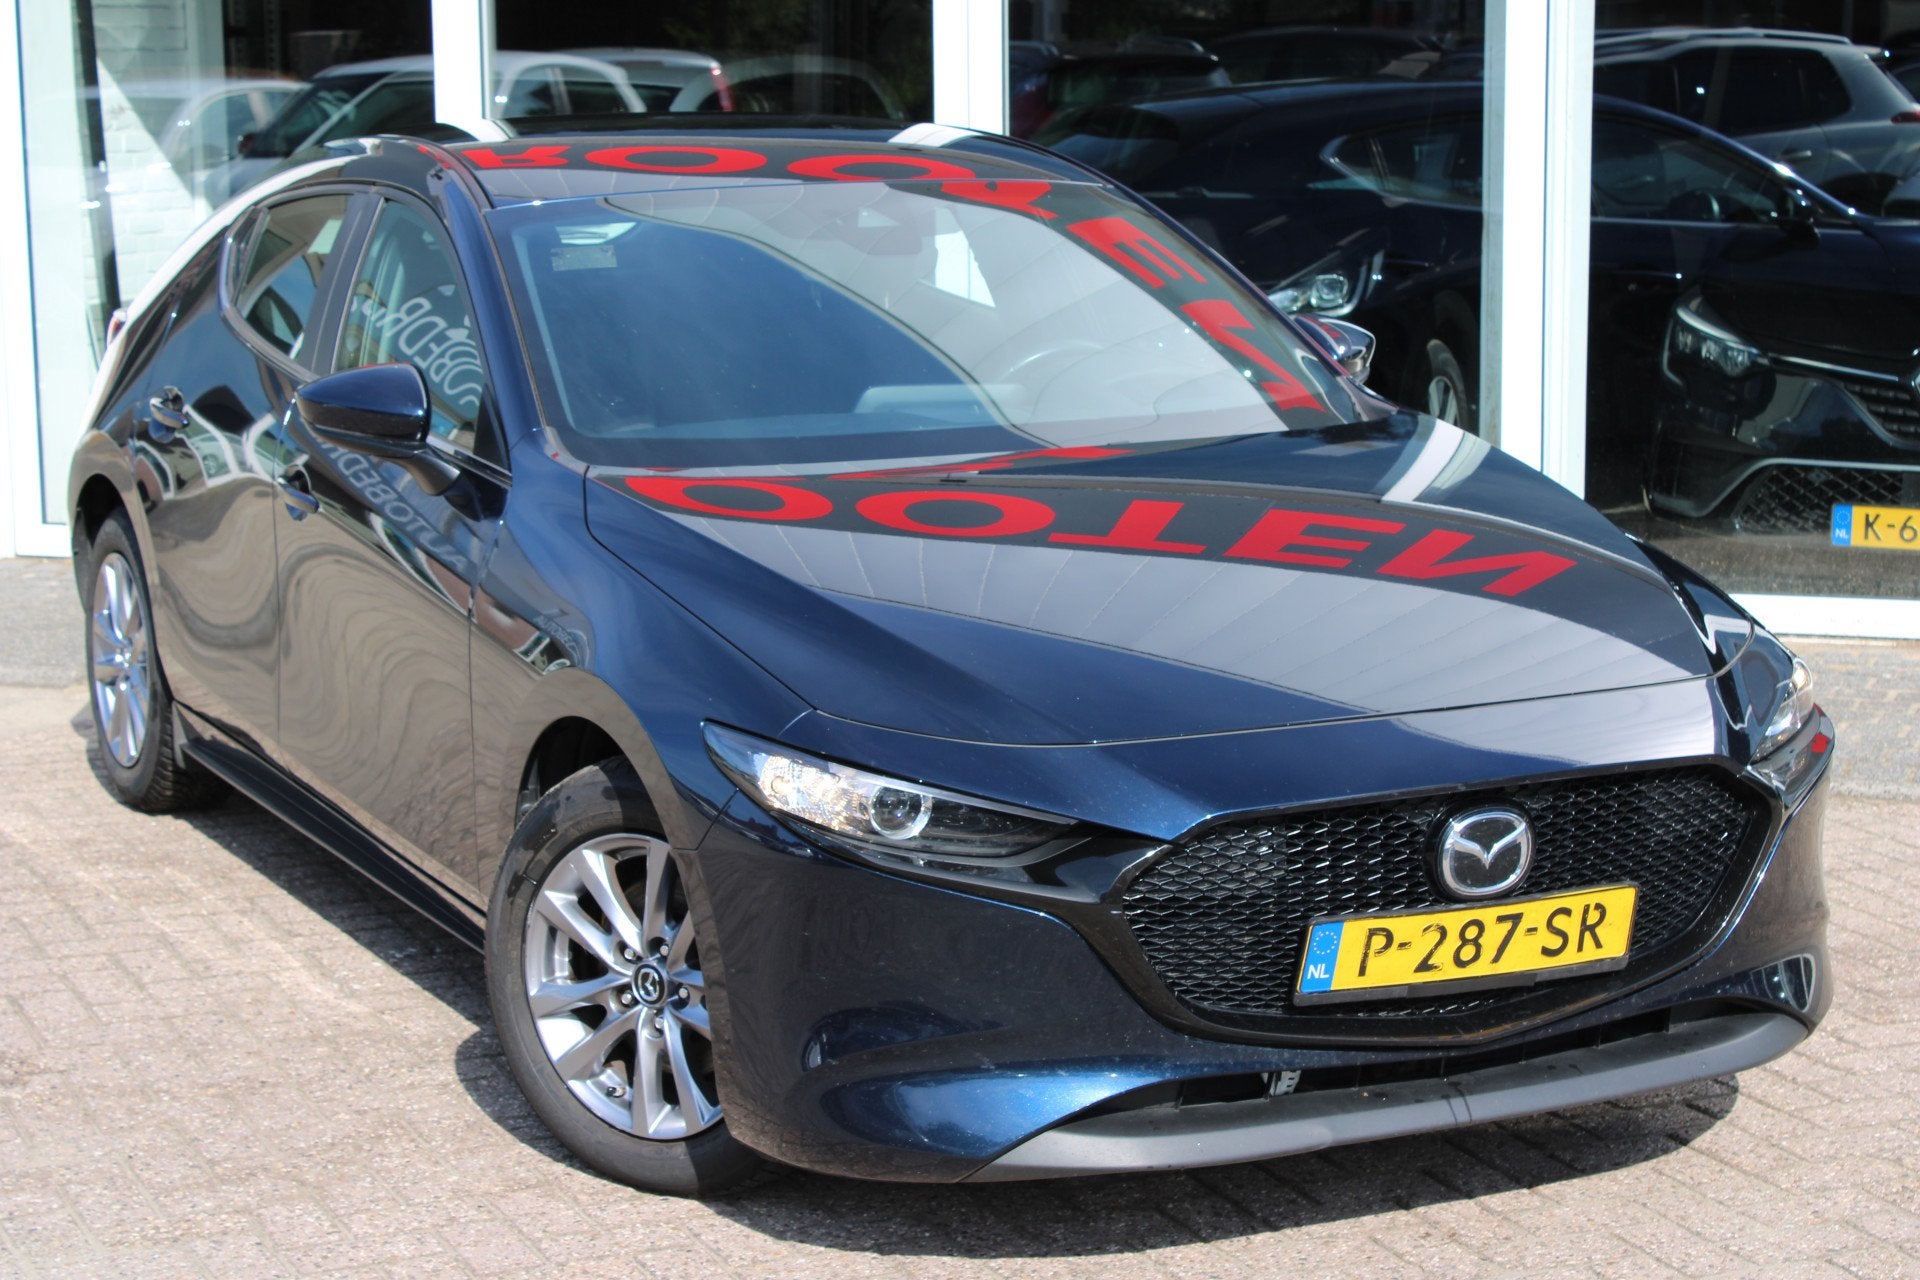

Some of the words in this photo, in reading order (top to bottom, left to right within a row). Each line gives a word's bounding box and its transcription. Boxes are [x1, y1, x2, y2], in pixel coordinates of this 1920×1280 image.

[1835, 528, 1849, 540] NL
[1307, 963, 1330, 979] NL
[1357, 902, 1607, 977] P-287-SR
